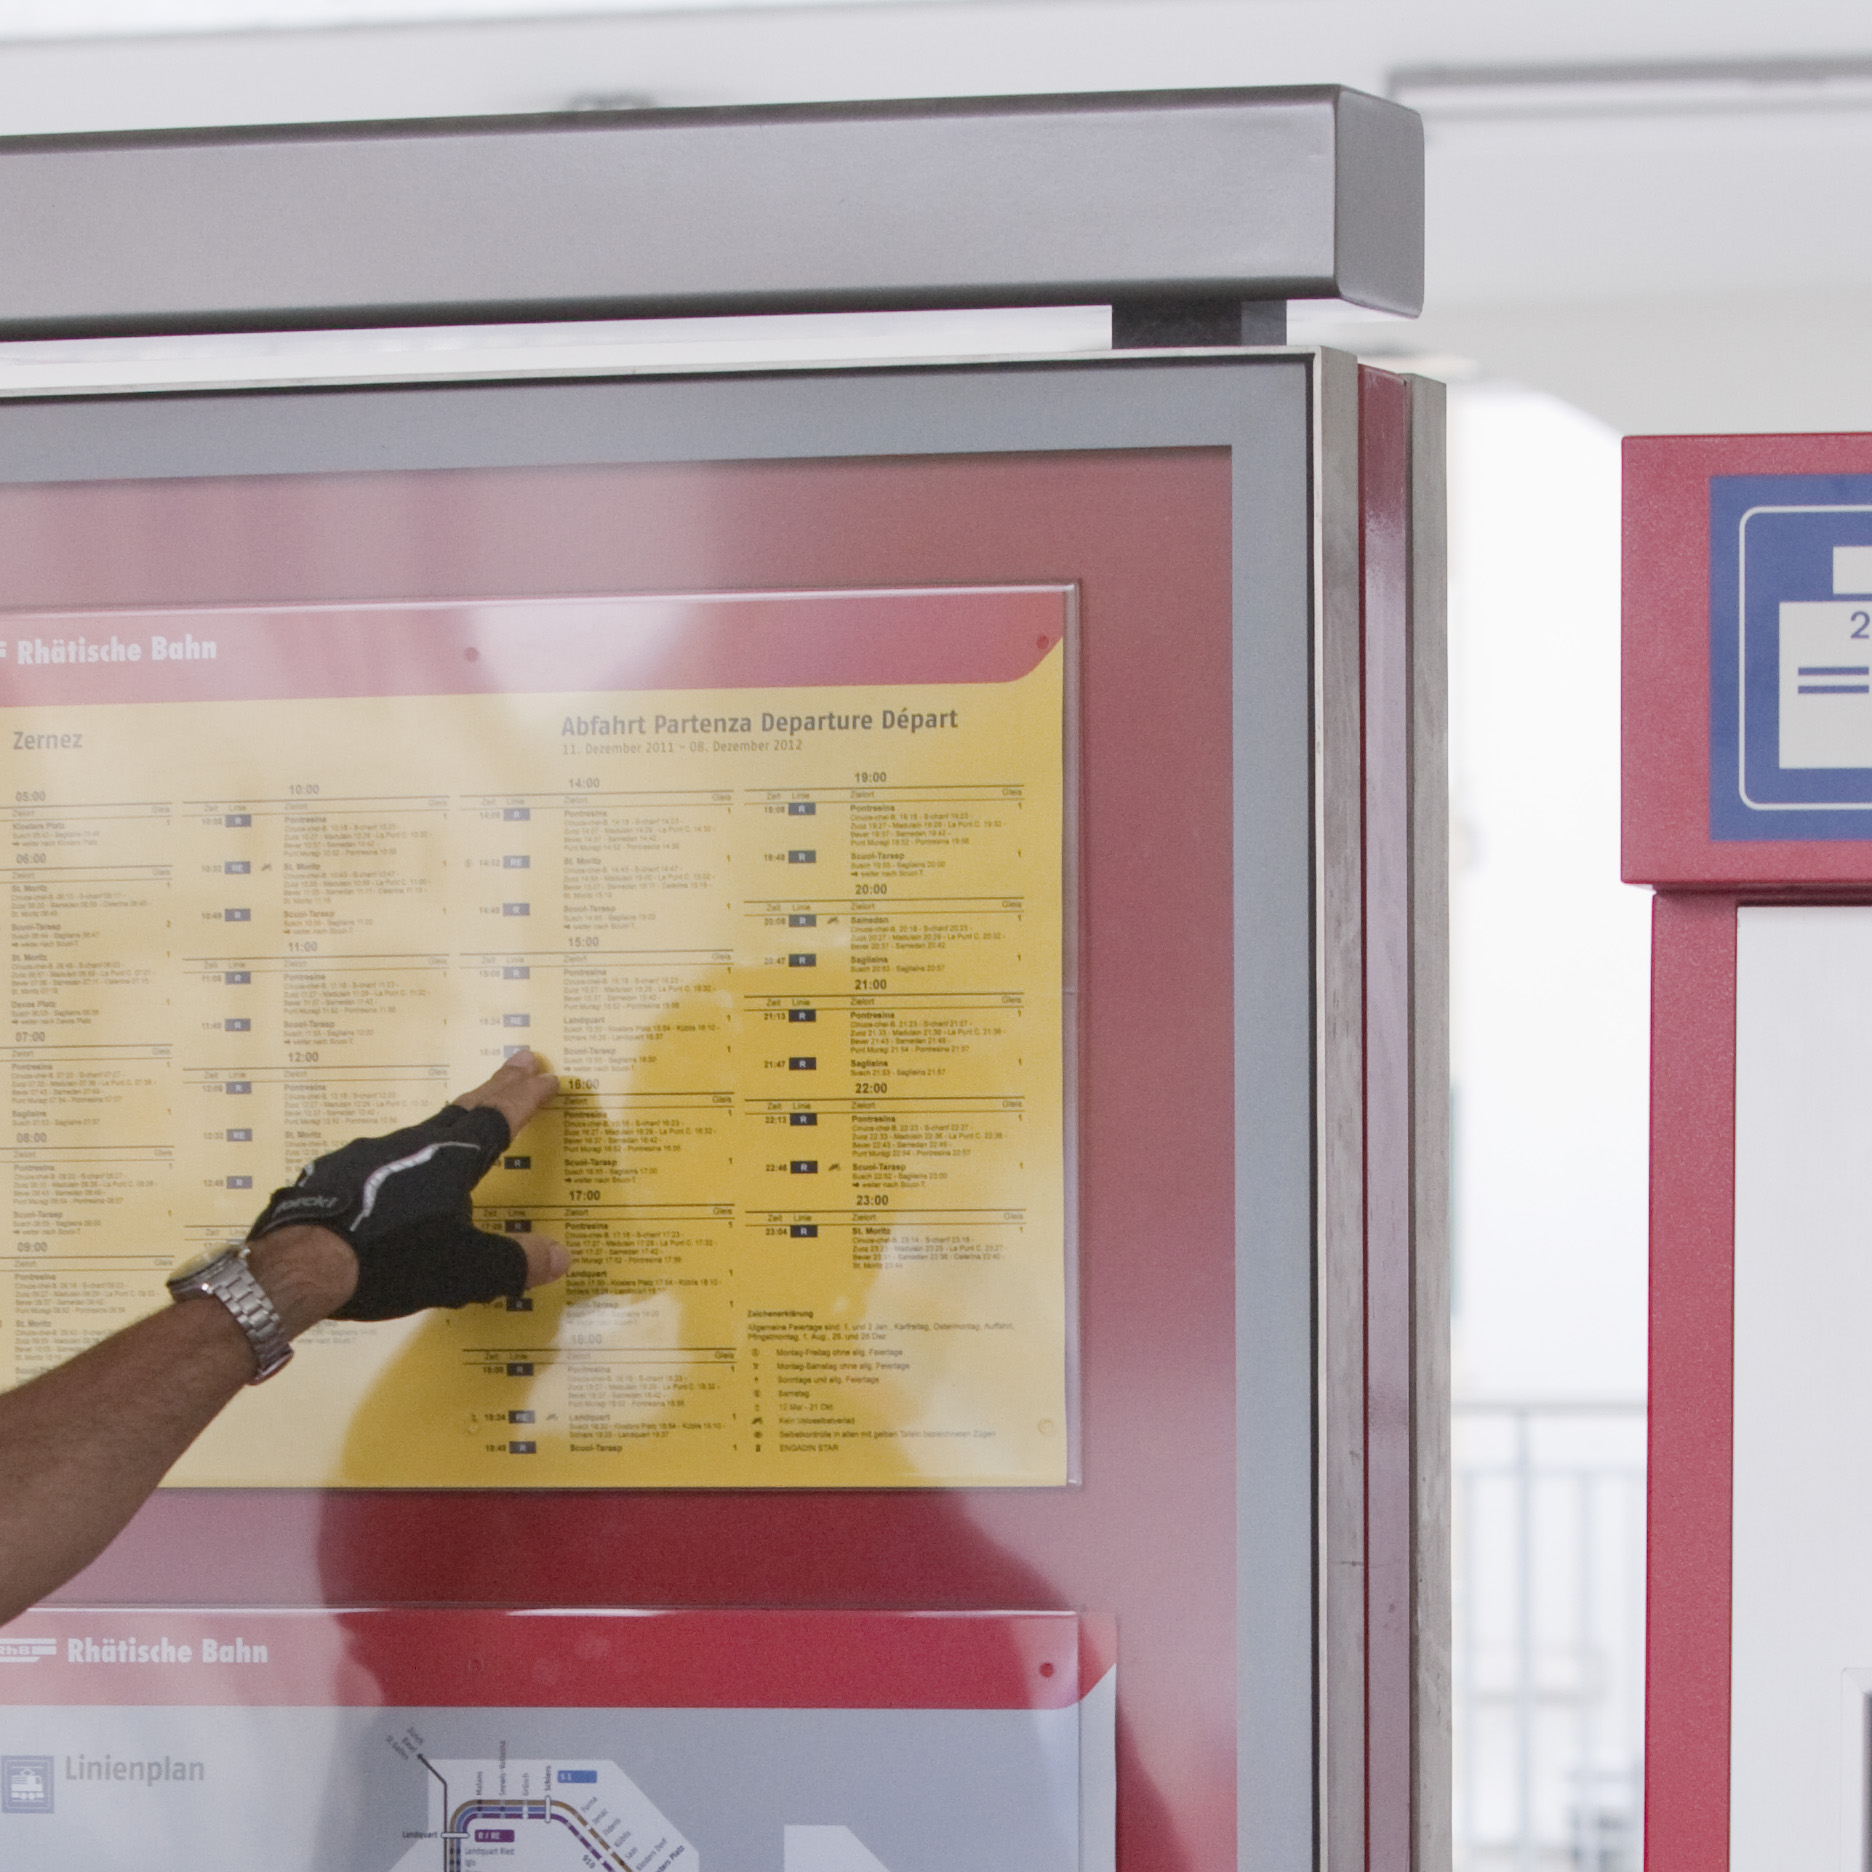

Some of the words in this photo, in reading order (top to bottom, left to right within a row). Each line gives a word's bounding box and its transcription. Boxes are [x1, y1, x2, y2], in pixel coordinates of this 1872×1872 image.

[1850, 611, 1871, 640] 2
[16, 635, 143, 666] Rhätische
[150, 633, 218, 662] Bahn
[561, 711, 647, 738] Abfahrt
[654, 711, 753, 735] Partenza
[761, 709, 874, 735] Departure
[881, 706, 959, 734] Départ
[12, 728, 84, 752] Zernez
[585, 741, 642, 756] Dezember
[645, 740, 675, 754] 2011
[714, 738, 770, 753] Dezember
[773, 737, 803, 752] 2012
[568, 777, 600, 789] 14:00
[854, 771, 887, 783] 19:00
[288, 784, 320, 796] 10:00
[855, 883, 888, 896] 20:00
[567, 936, 600, 948] 15:00
[854, 978, 887, 991] 21:00
[286, 1051, 320, 1063] 12:00
[855, 1082, 888, 1094] 22:00
[568, 1189, 601, 1202] 17:00
[856, 1195, 889, 1207] 23:00
[66, 1635, 194, 1664] Rhätische
[201, 1636, 269, 1664] Bahn
[64, 1754, 206, 1785] Linienplan
